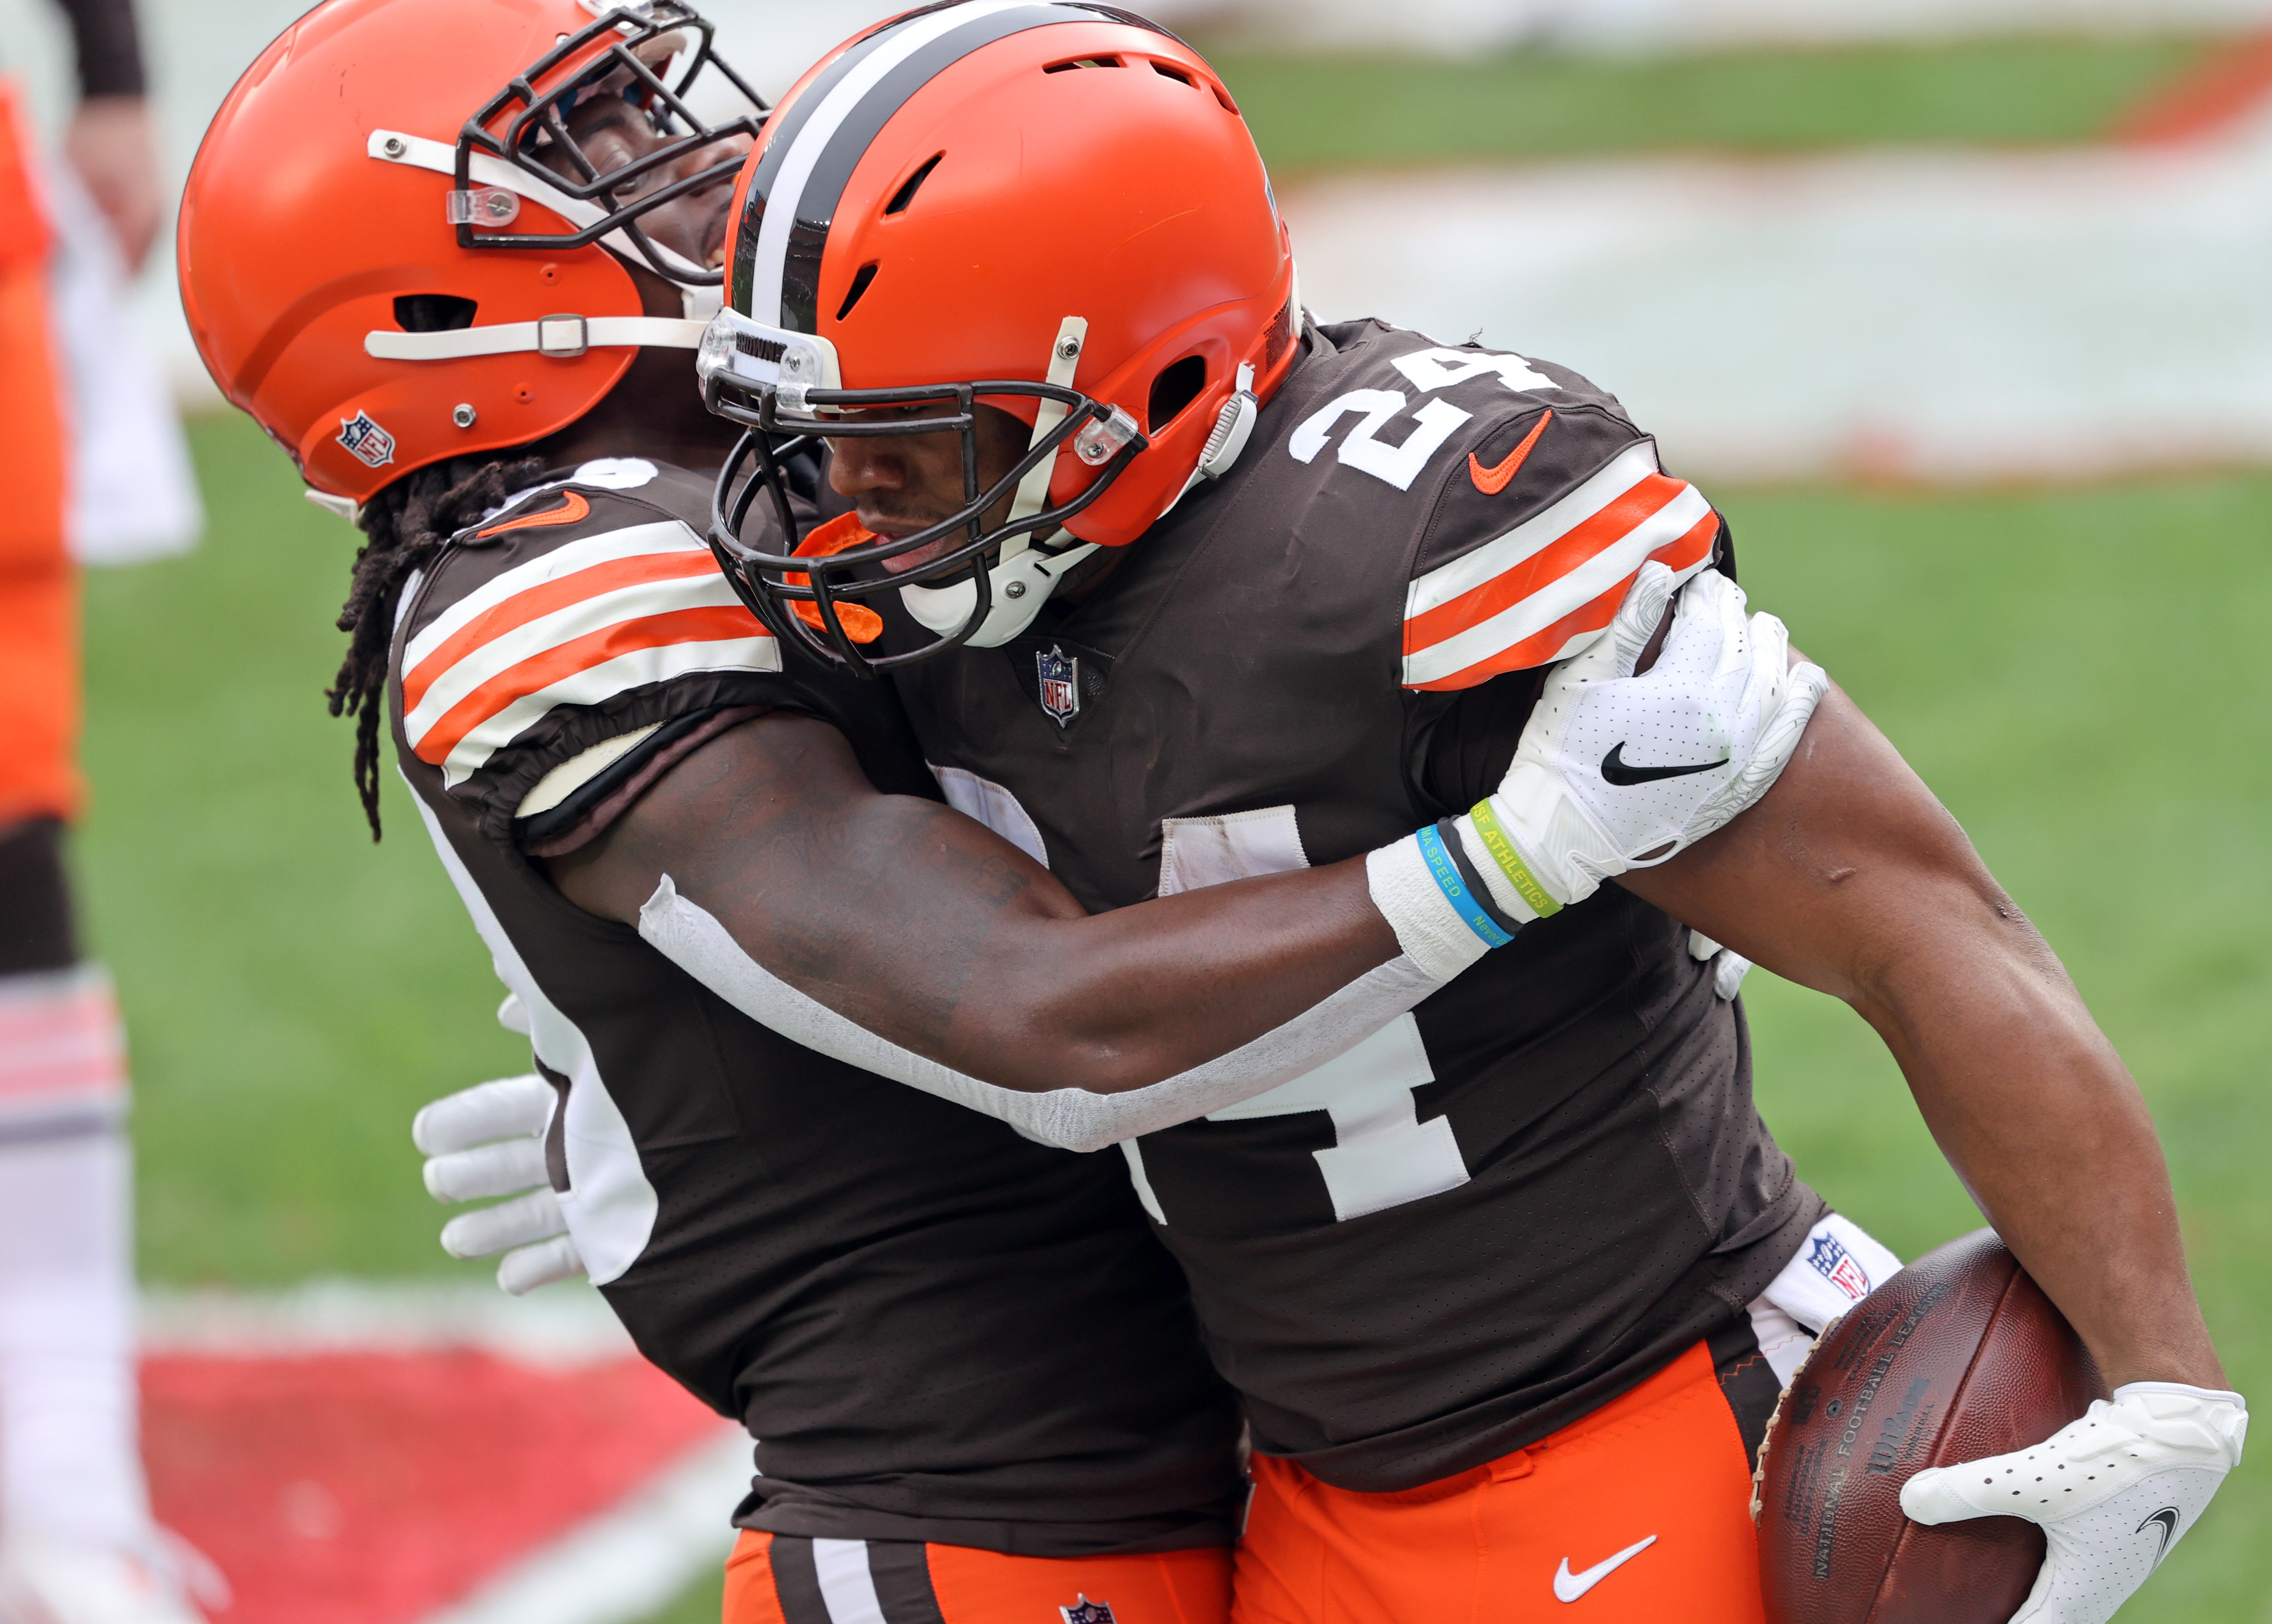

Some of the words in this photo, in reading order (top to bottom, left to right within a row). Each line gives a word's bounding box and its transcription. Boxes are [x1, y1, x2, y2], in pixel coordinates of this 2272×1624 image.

[736, 331, 788, 364] BROWNS
[1288, 346, 1562, 492] 24
[357, 433, 390, 462] NFL
[1045, 681, 1071, 711] NFL
[1427, 847, 1461, 897] SPEED
[1473, 799, 1491, 825] USF
[1484, 829, 1548, 908] ATHLETICS
[1473, 915, 1500, 944] Never
[1832, 1259, 1867, 1299] NFL
[1814, 1464, 1848, 1580] NATIONAL
[1836, 1352, 1896, 1459] FOOTBALL
[1889, 1282, 1950, 1348] LEAGUE
